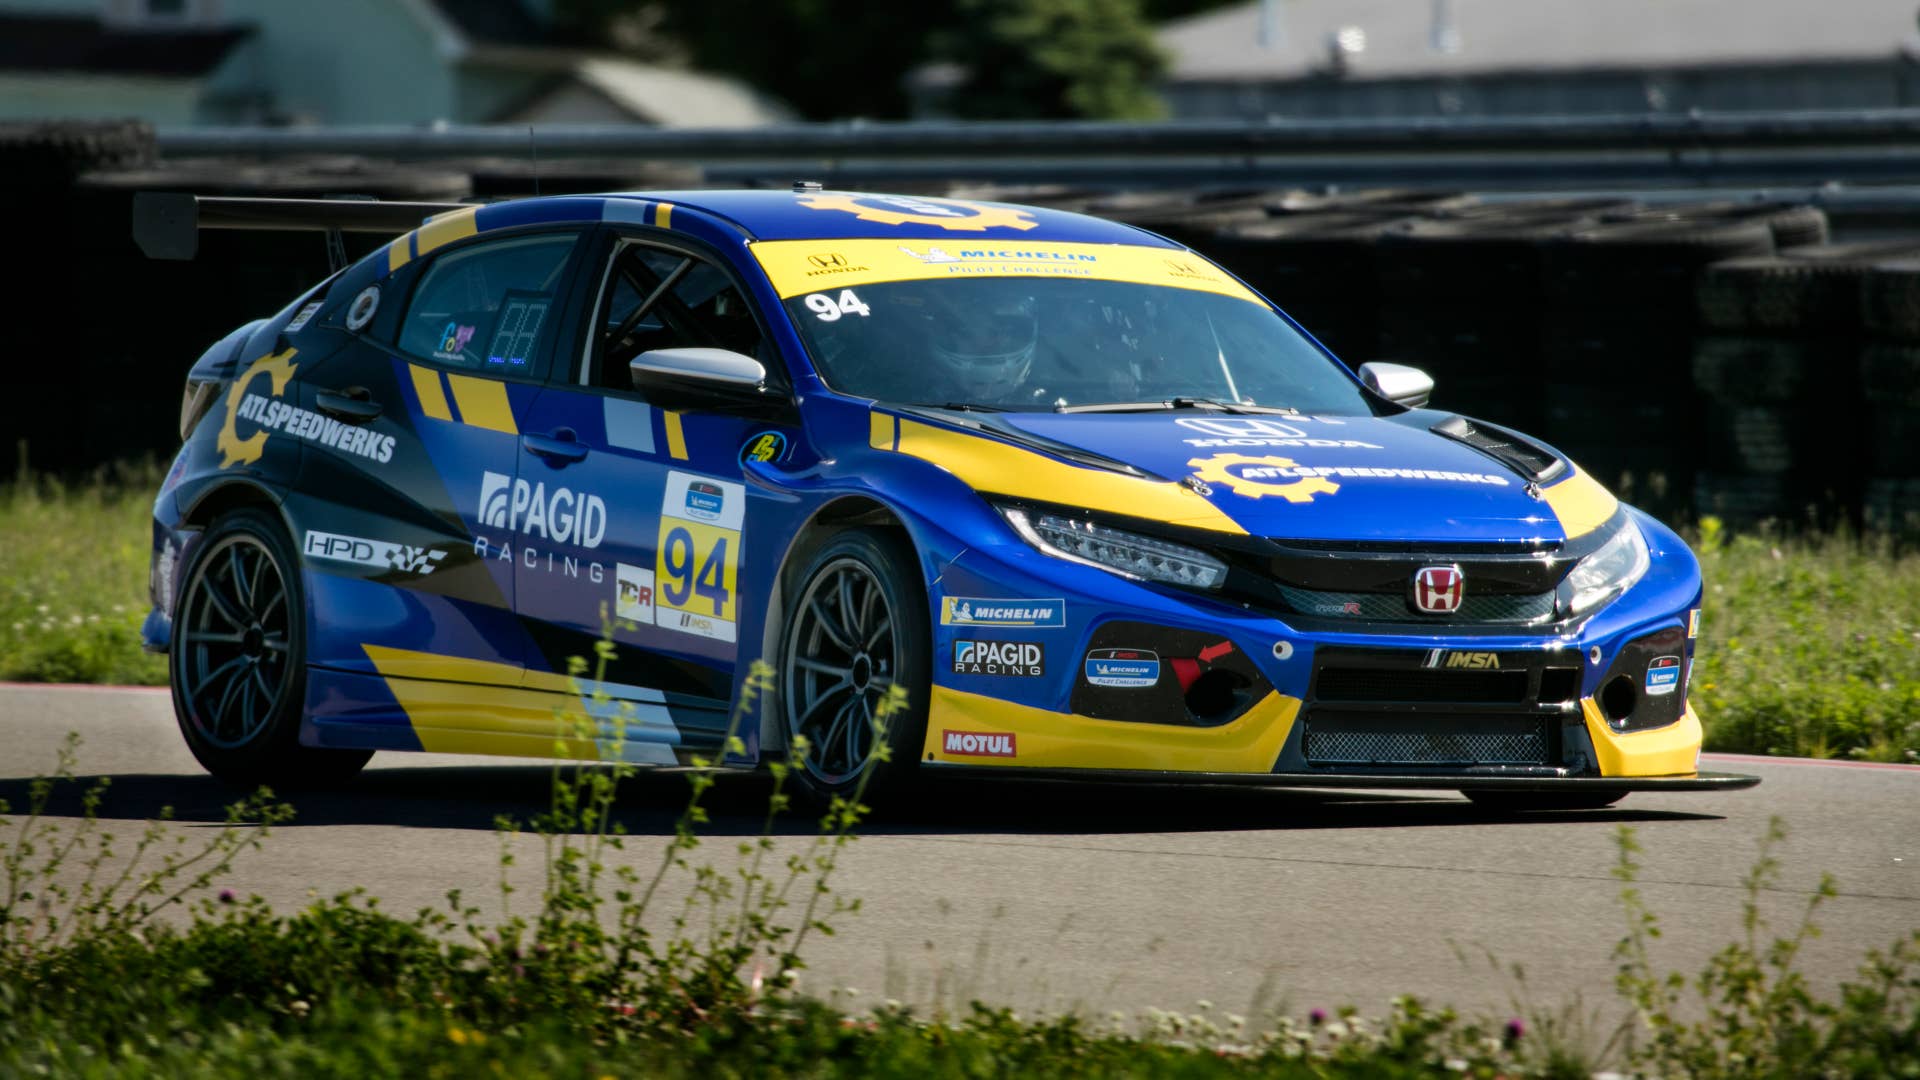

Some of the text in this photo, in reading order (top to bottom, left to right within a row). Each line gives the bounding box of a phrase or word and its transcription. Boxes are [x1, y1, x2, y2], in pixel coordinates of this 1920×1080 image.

[959, 250, 1097, 262] MICHELIN
[806, 264, 871, 277] HONDA
[804, 288, 871, 322] 94
[237, 393, 397, 464] ATLSPEEDWERKS
[1183, 439, 1384, 449] HONDA
[1241, 466, 1510, 486] ATLSPEEDWERKS
[509, 478, 607, 549] PAGID
[307, 534, 374, 562] HPD
[473, 536, 604, 584] RACING
[663, 526, 729, 617] 94
[618, 579, 653, 607] TCR
[975, 607, 1053, 619] MICHELIN
[976, 642, 1041, 666] PAGID
[1446, 652, 1500, 669] IMSA
[955, 663, 1041, 675] RACING
[946, 733, 1014, 754] MOTUL
